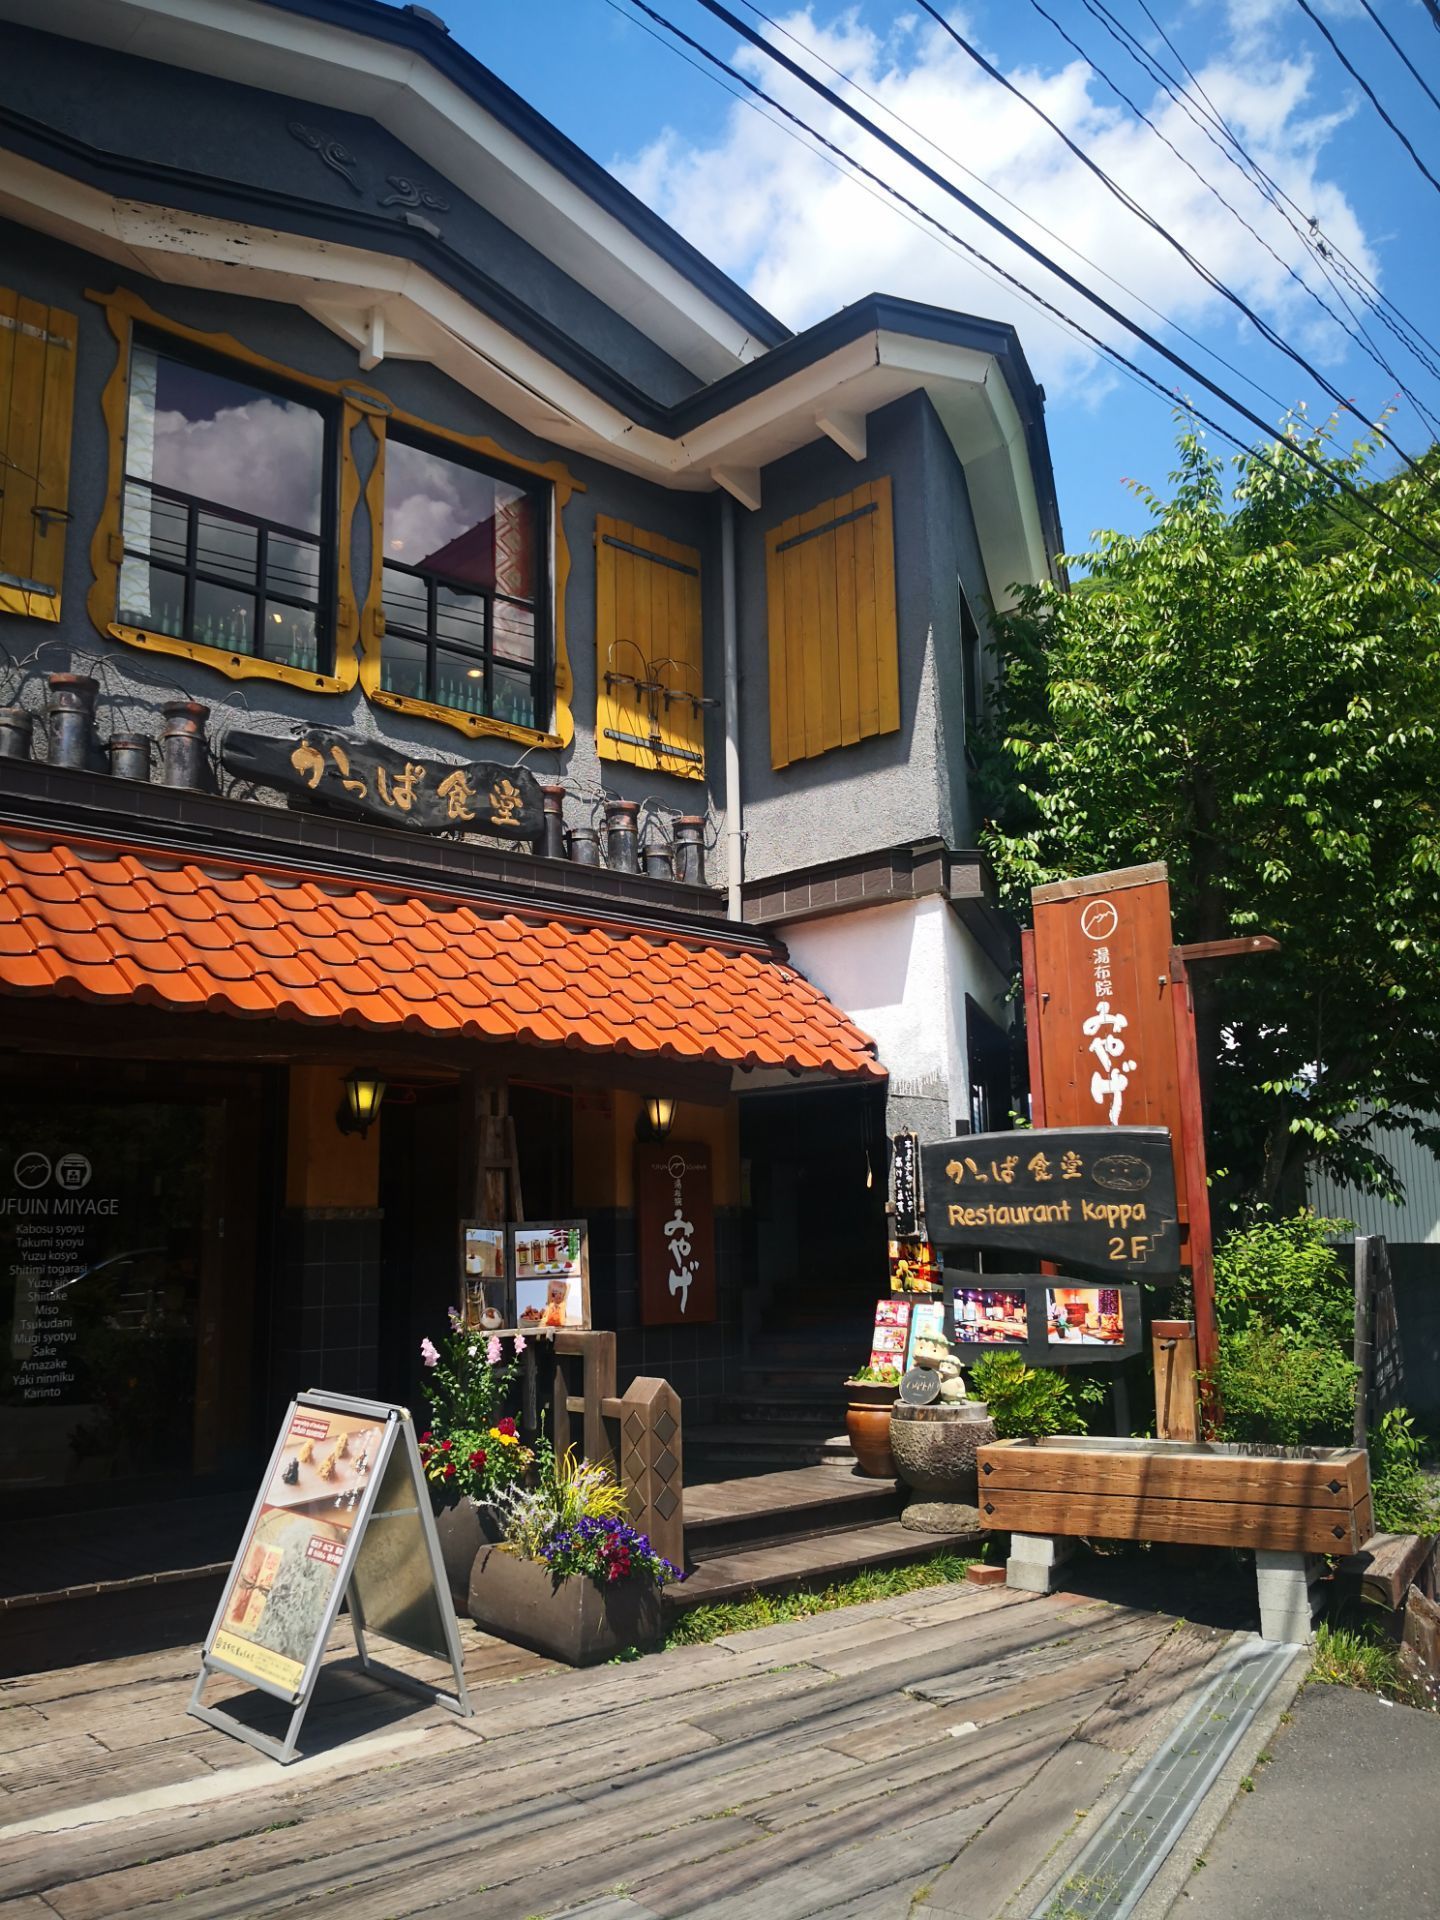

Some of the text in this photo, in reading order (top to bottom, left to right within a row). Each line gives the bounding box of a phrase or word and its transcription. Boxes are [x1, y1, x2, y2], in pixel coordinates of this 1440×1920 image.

[290, 739, 524, 827] かっぱ食堂
[1092, 946, 1114, 997] 湯布院
[1082, 1000, 1138, 1126] みやげ
[945, 1150, 1084, 1185] かっぱ食堂
[53, 1198, 119, 1216] MIYAGE
[948, 1200, 1071, 1226] Restaurant
[16, 1223, 85, 1236] Kabosu syoyu
[16, 1237, 85, 1249] Takumi syoyu
[1108, 1236, 1149, 1260] 2F
[21, 1250, 78, 1263] Yuzu kosyo
[663, 1208, 700, 1315] みやげ
[9, 1264, 46, 1276] Shitimi
[27, 1278, 52, 1288] Yuzu
[34, 1305, 59, 1315] Miso
[20, 1317, 73, 1329] Tsukudani
[14, 1331, 77, 1345] Mugi syotyu
[32, 1346, 57, 1357] Sake
[20, 1359, 68, 1371] Amazake
[12, 1372, 75, 1386] Yaki ninniku
[24, 1387, 61, 1399] Karinto
